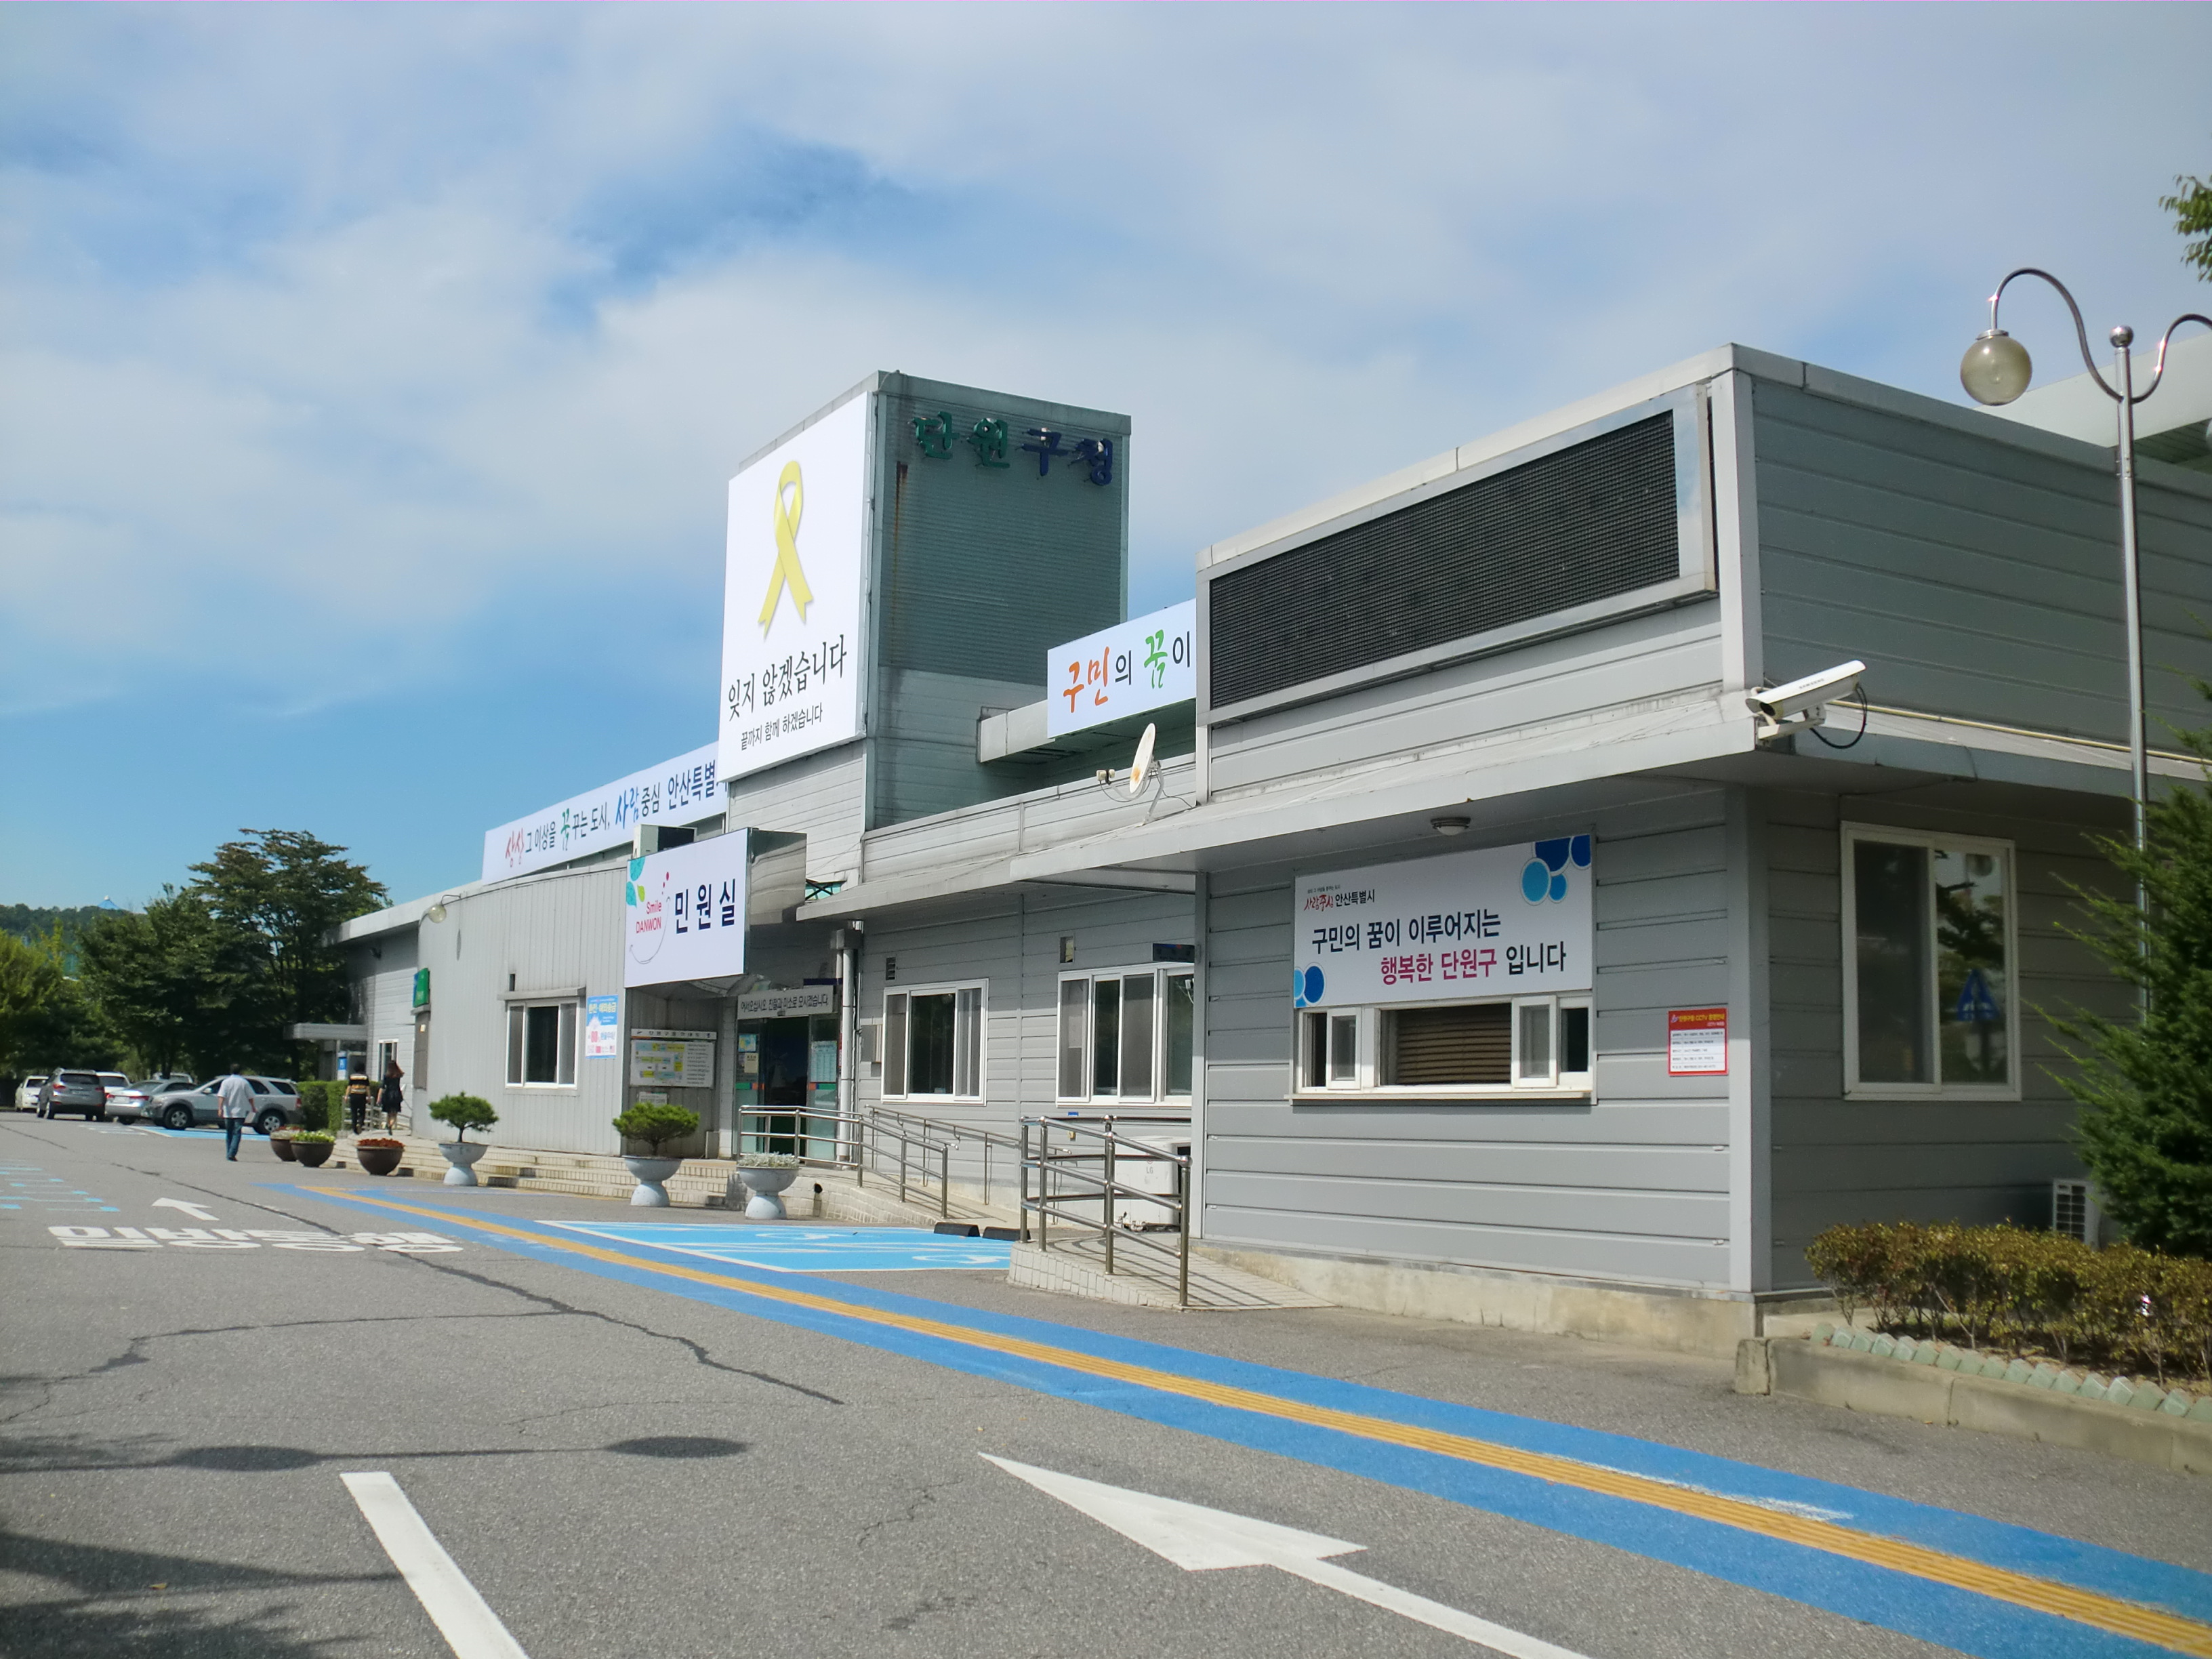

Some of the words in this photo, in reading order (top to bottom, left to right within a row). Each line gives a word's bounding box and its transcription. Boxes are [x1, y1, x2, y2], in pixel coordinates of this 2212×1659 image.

[911, 411, 1113, 486] 단원구청
[728, 672, 755, 722] 잊지
[762, 634, 847, 707] 않겠습니다
[1063, 646, 1132, 713] 구민의
[1143, 629, 1191, 689] 꿈이
[741, 724, 762, 751] 끝까지
[764, 718, 780, 741] 함께
[782, 701, 823, 734] 하겠습니다
[525, 832, 532, 853] 그
[534, 821, 556, 852] 이상을
[646, 900, 662, 915] Smile
[675, 878, 736, 935] 민원실
[1335, 888, 1375, 907] 안산특별시
[636, 917, 662, 934] DANWON
[1311, 923, 1360, 955] 구민의
[1366, 918, 1400, 949] 꿈이
[1408, 909, 1501, 944] 이루어지는
[1380, 952, 1434, 986] 행복한
[1441, 948, 1498, 980] 단원구
[1506, 941, 1567, 975] 입니다
[1146, 1166, 1154, 1174] LG
[48, 1225, 464, 1253] 일방통행
